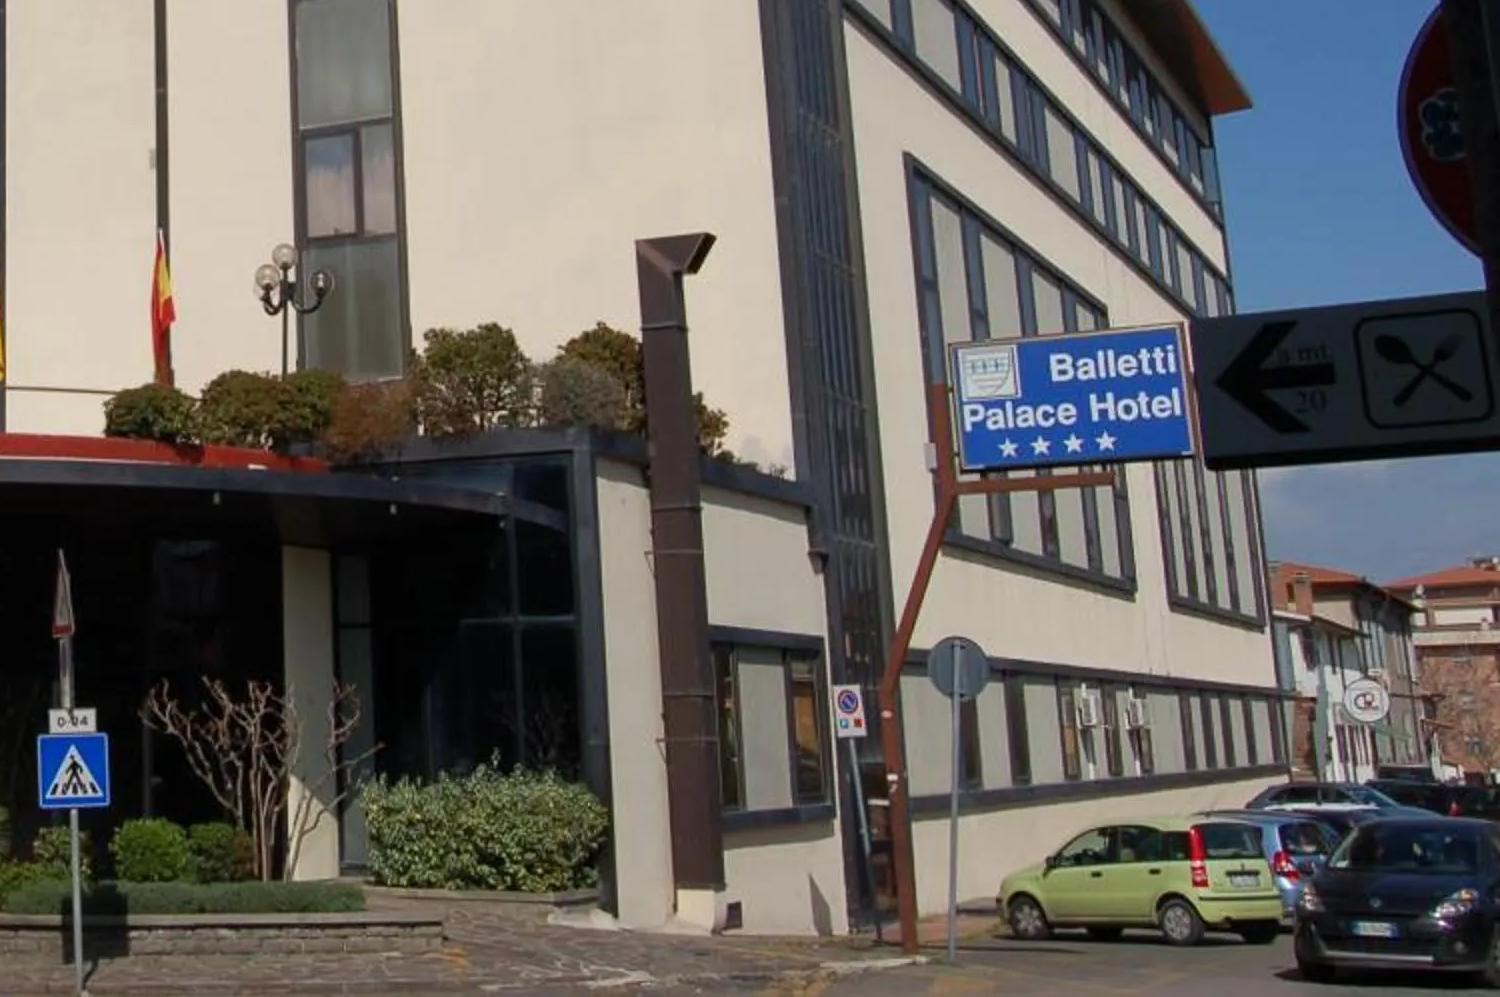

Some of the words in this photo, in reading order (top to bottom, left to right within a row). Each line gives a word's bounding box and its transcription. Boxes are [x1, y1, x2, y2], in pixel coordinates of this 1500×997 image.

[1049, 344, 1177, 382] Balletti
[963, 401, 1077, 432] Palace
[1089, 387, 1182, 422] Hotel
[1295, 390, 1328, 413] 20
